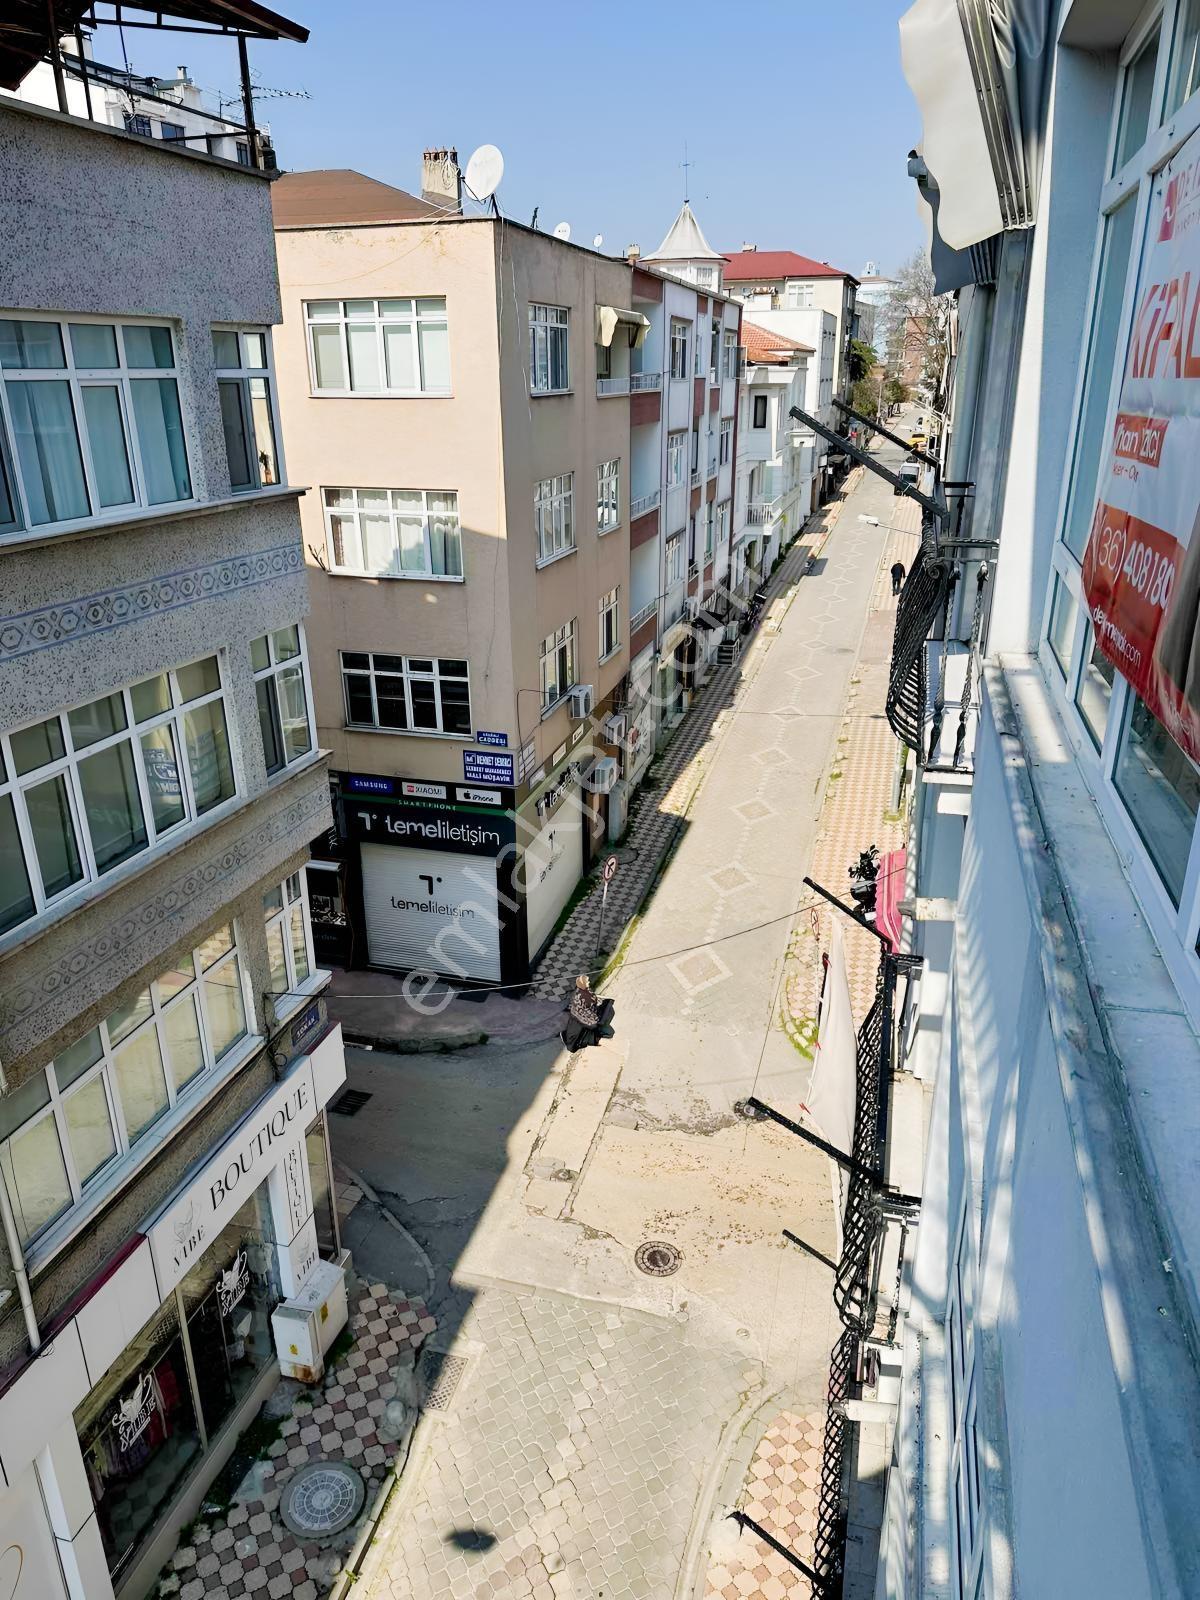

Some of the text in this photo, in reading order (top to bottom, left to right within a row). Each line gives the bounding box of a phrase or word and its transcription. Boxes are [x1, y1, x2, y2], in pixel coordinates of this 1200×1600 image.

[354, 780, 388, 790] SAMSUNG
[415, 785, 442, 796] XIAOMI
[385, 814, 500, 846] temeliletişim
[208, 1082, 309, 1211] BOUTIQUE
[173, 1224, 206, 1275] VIBE
